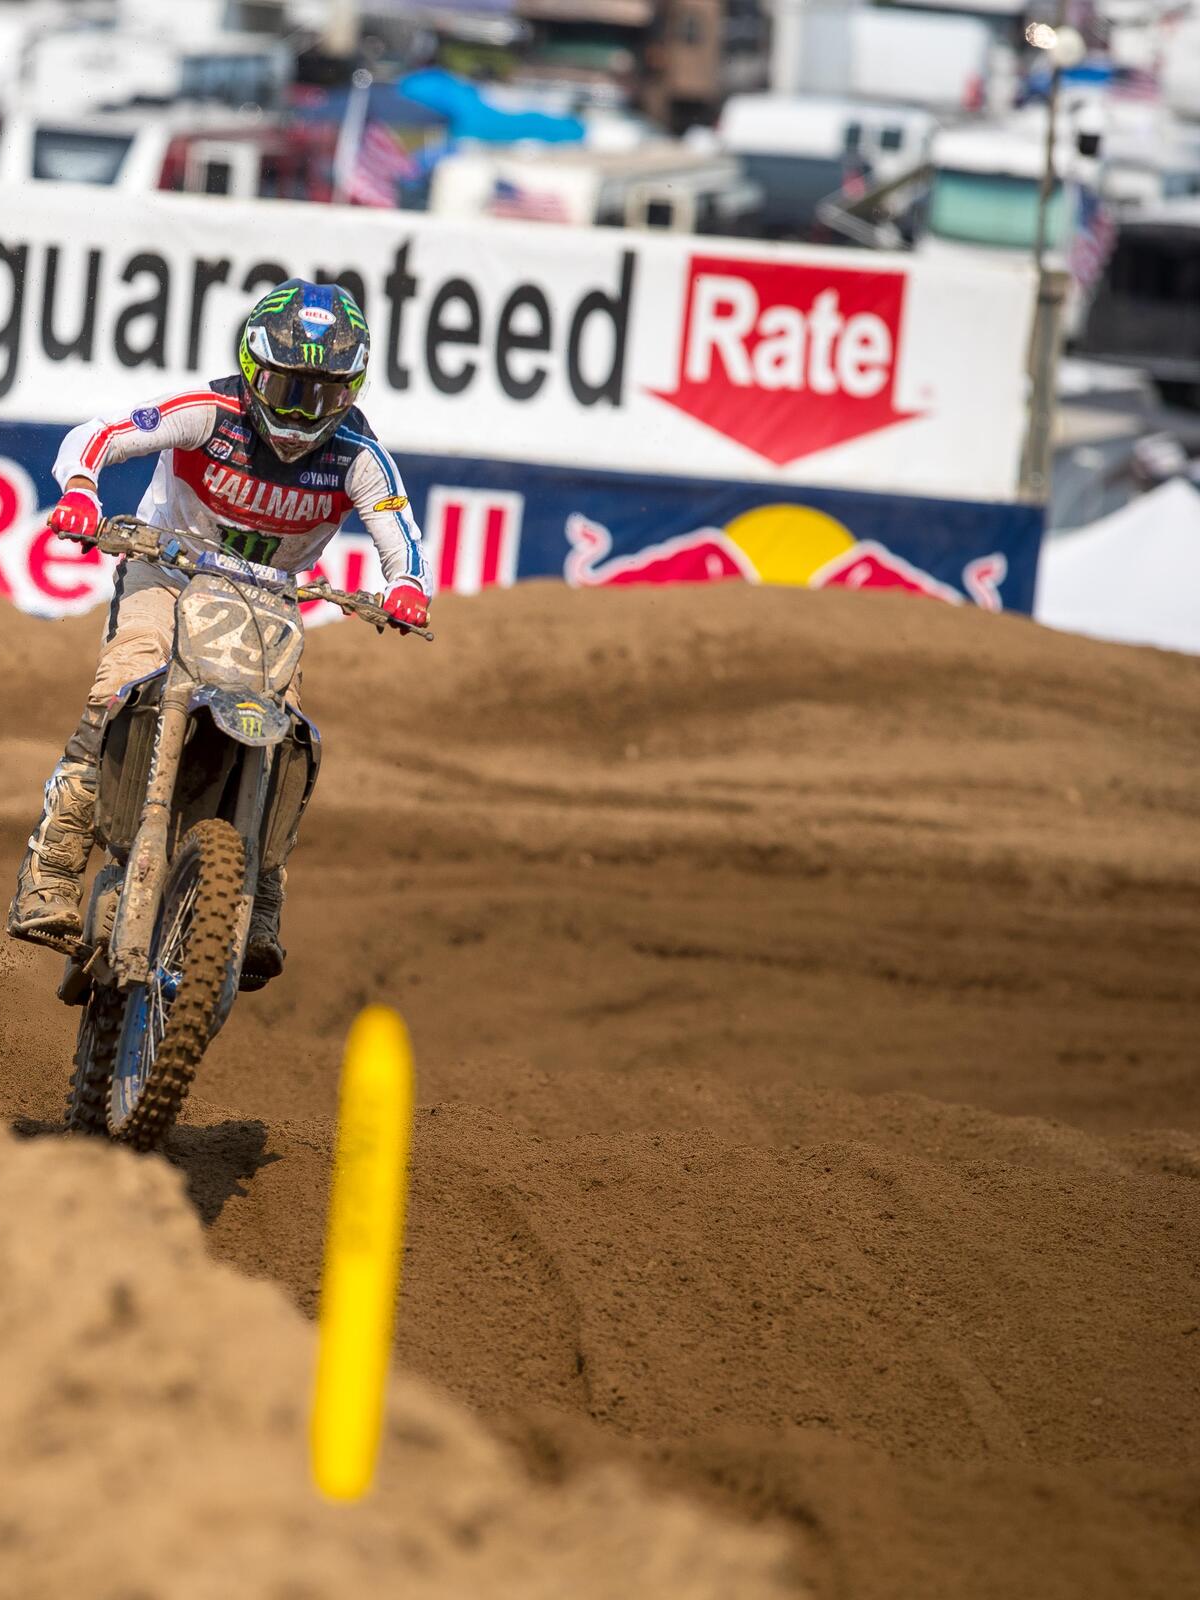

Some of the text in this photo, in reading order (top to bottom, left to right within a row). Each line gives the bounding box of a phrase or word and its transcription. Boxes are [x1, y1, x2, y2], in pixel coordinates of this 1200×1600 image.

[305, 310, 330, 321] BELL
[685, 274, 894, 398] Rate
[202, 463, 333, 522] HALLMAN
[221, 582, 259, 599] LUAS
